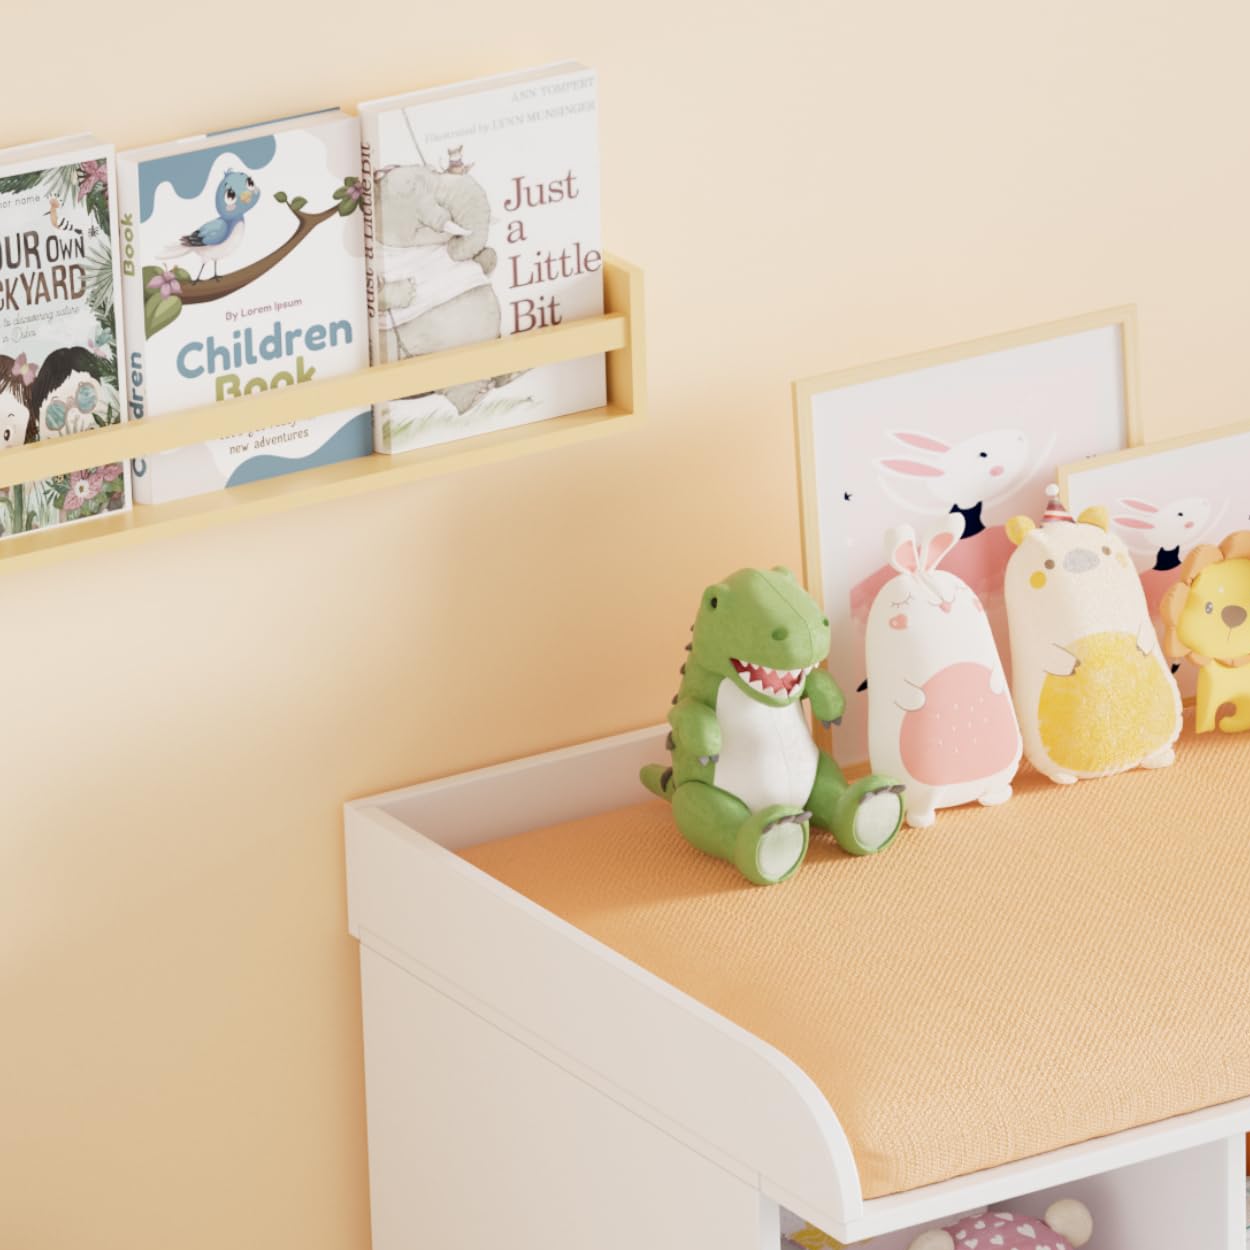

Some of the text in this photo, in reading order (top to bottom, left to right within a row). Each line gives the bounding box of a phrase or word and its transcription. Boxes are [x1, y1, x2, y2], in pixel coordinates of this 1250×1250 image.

[15, 194, 41, 207] name
[503, 169, 580, 212] Just
[0, 231, 85, 270] UR OWN
[507, 220, 528, 244] a
[508, 242, 602, 289] Little
[0, 264, 86, 311] KYARD
[225, 298, 303, 322] By Lorem Ipsum
[509, 295, 563, 335] Bit
[121, 212, 147, 478] Cdren Book
[176, 320, 354, 379] Children
[229, 441, 250, 456] new
[254, 428, 310, 449] adventures
